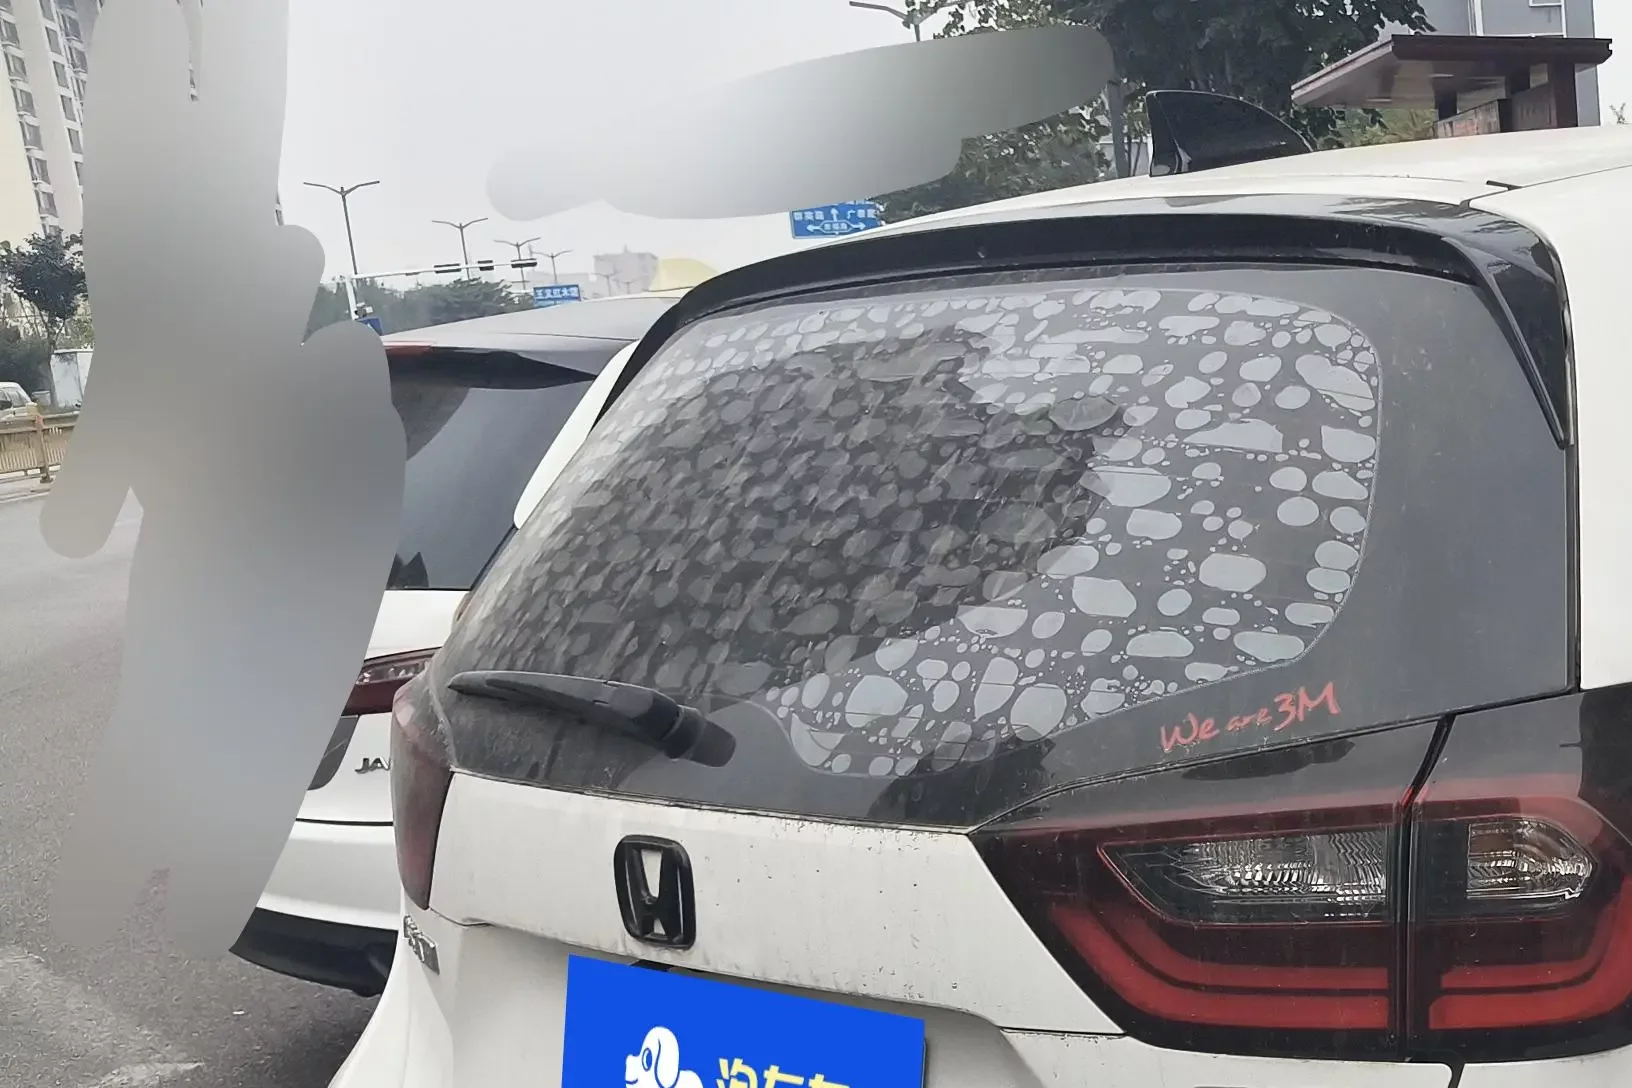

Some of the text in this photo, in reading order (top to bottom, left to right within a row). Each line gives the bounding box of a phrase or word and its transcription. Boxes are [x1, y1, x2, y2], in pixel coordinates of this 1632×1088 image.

[1160, 681, 1341, 752] We are 3M
[354, 756, 391, 774] JA
